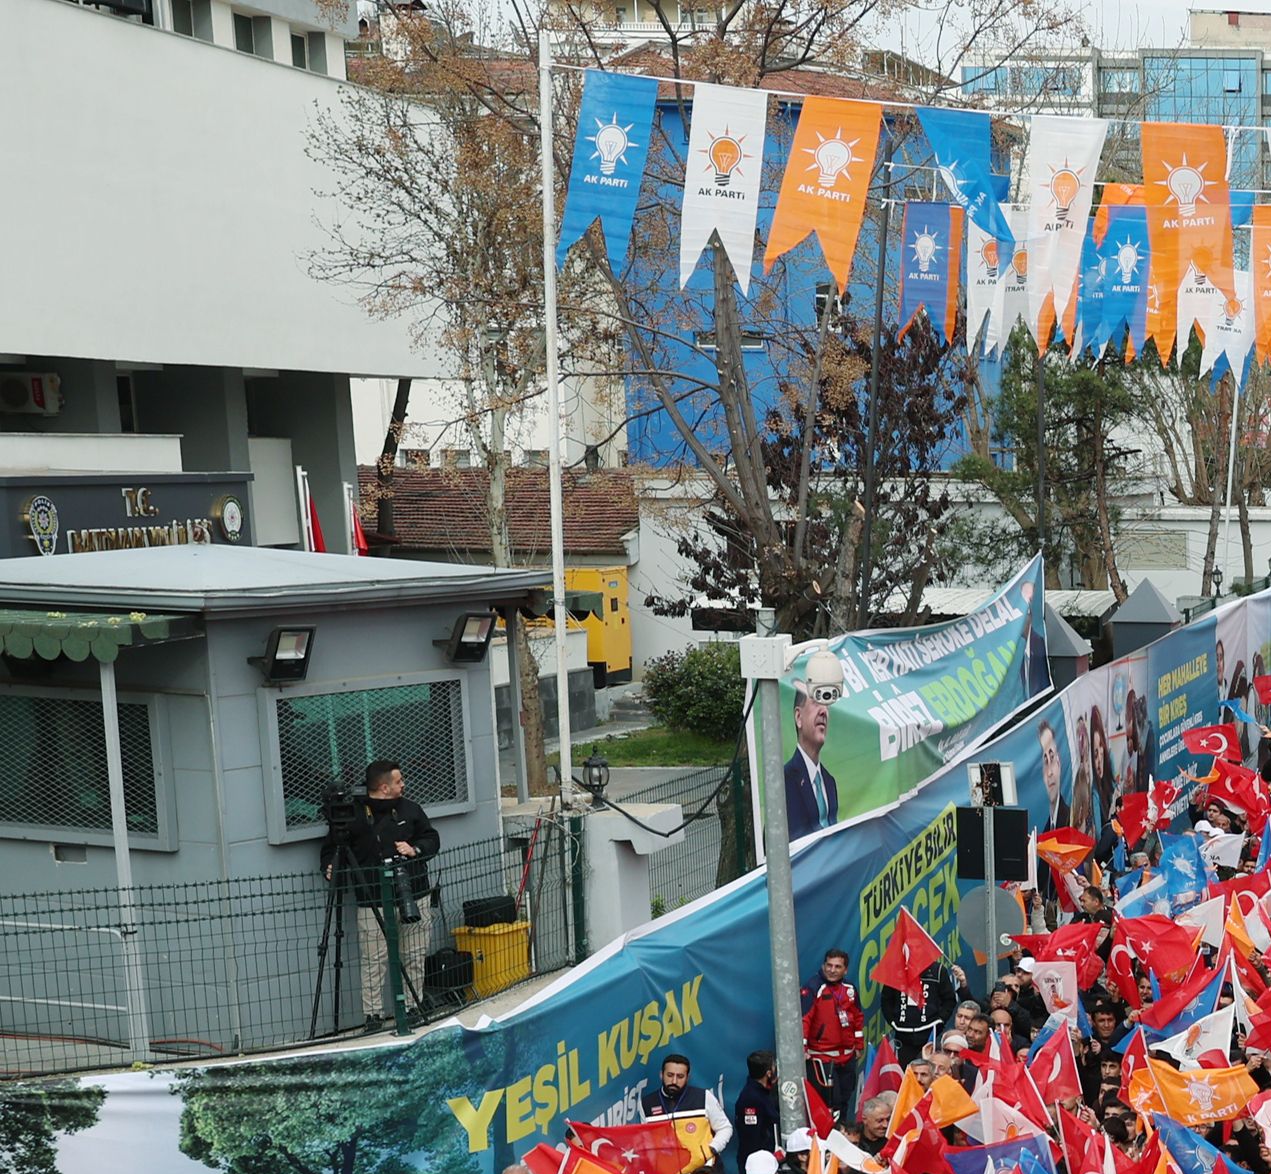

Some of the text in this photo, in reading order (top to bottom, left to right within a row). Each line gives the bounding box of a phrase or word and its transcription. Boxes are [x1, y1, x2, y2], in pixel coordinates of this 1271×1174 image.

[584, 173, 603, 185] AK
[698, 187, 714, 197] AK
[797, 183, 816, 195] AK
[1162, 218, 1179, 229] AK
[863, 811, 957, 928] TÜRKİYE BİLİR
[446, 1041, 591, 1153] YEŞİL
[597, 974, 705, 1087] KUŞAK
